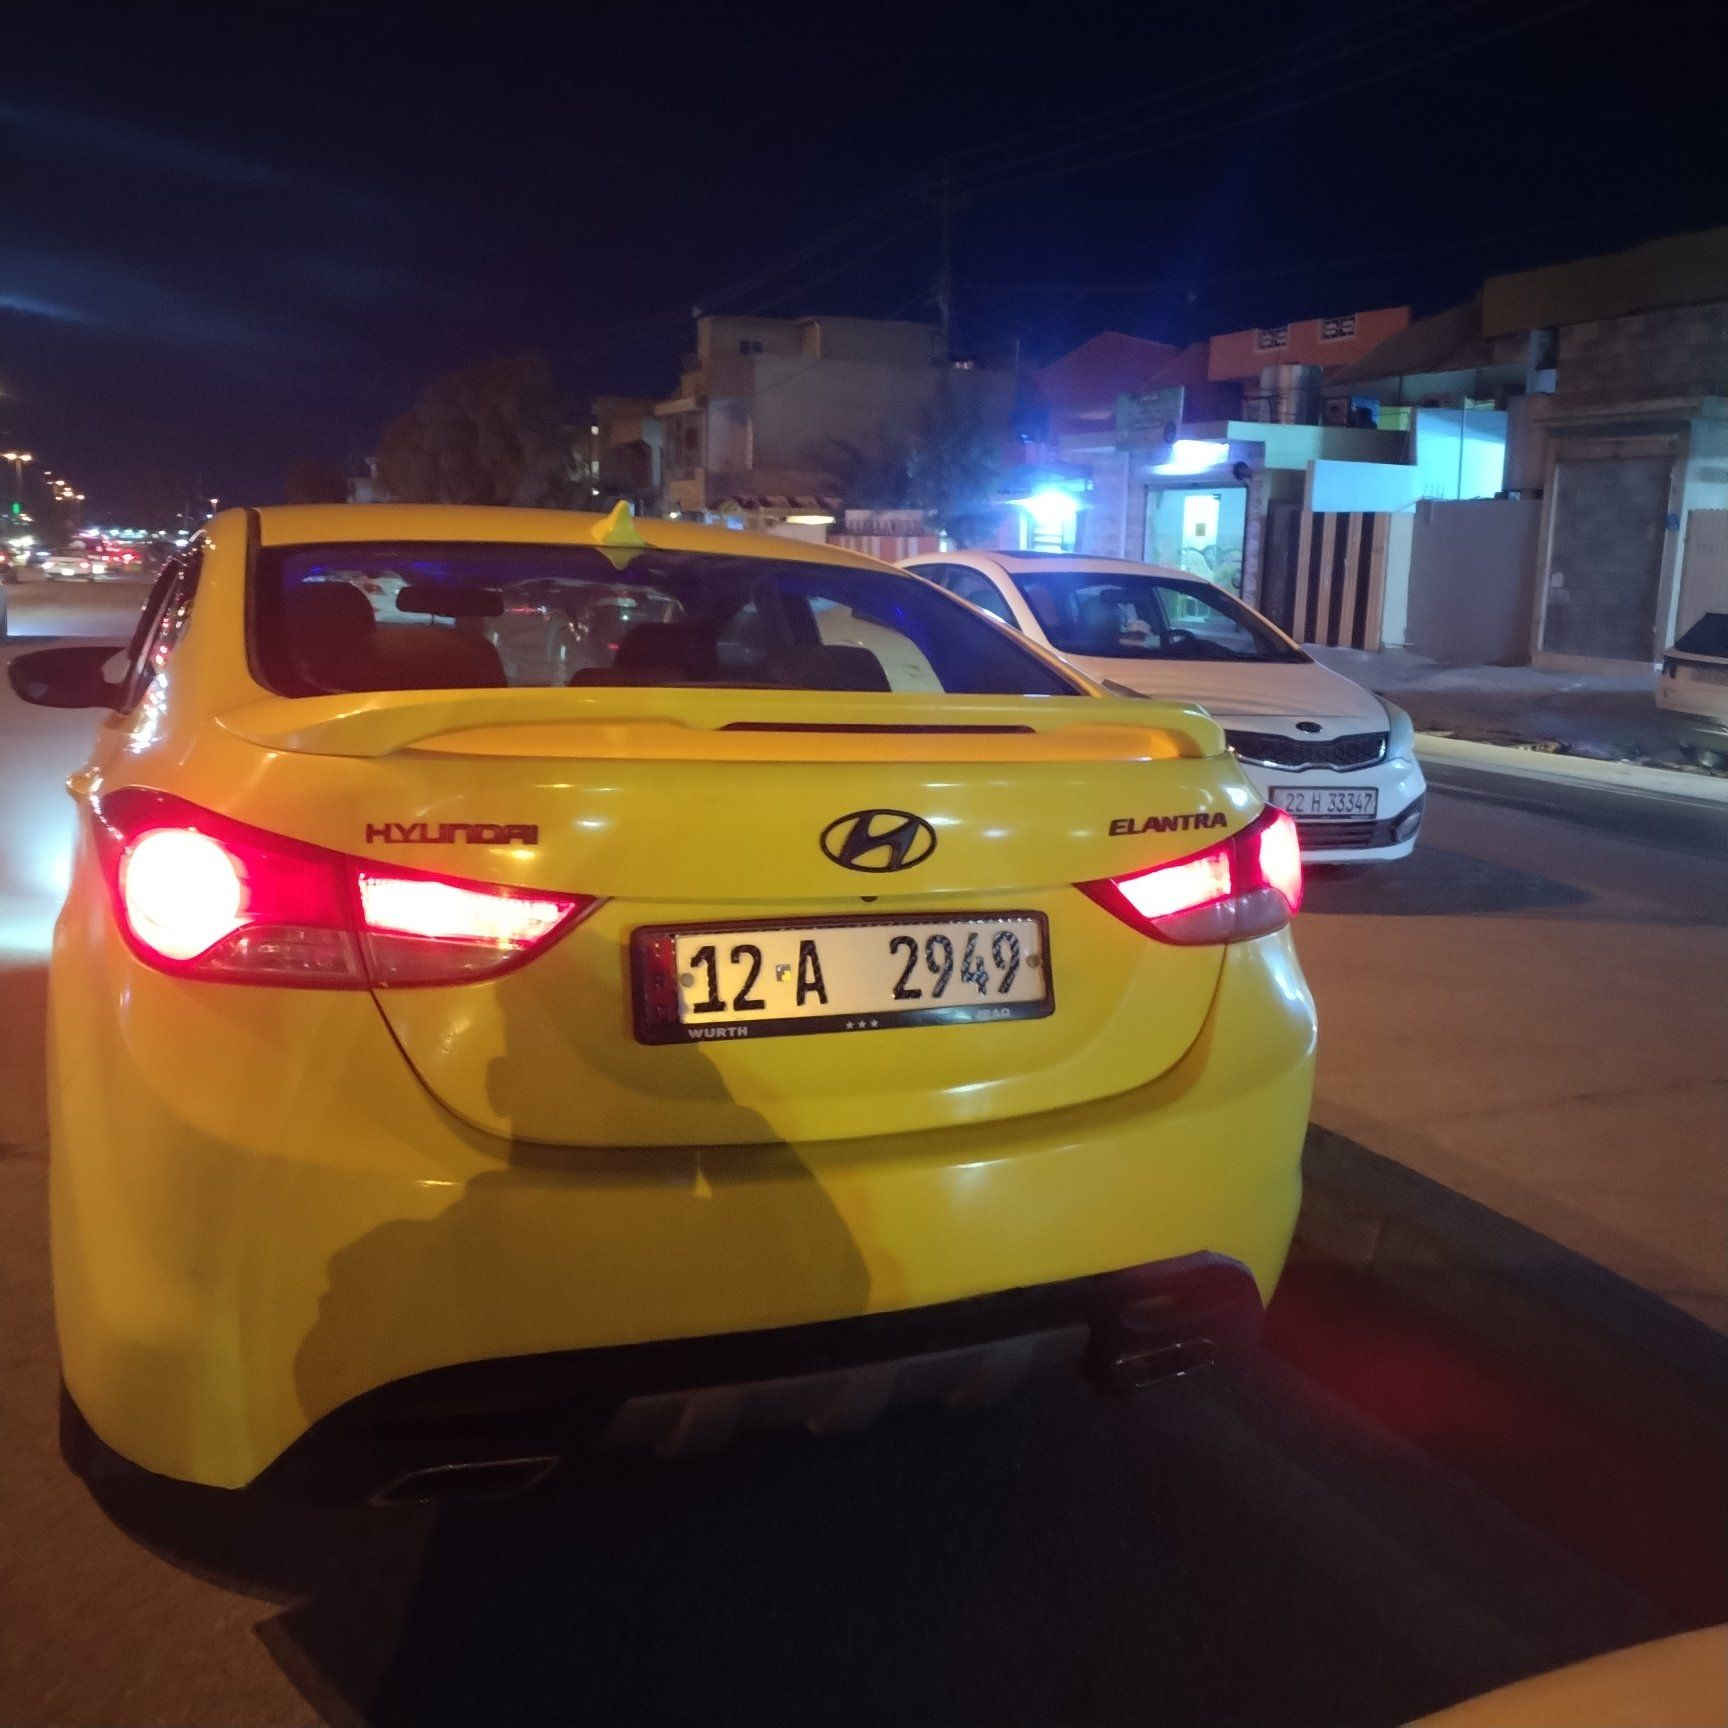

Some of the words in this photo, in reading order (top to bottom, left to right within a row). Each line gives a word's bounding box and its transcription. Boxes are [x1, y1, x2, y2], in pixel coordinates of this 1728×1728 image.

[1286, 793, 1304, 812] 22
[1312, 792, 1321, 812] H
[1327, 793, 1373, 812] 33347
[1109, 812, 1227, 836] ELANTRA
[690, 944, 765, 1014] 12
[797, 940, 828, 1006] A
[889, 931, 1020, 1000] 2949
[688, 1026, 748, 1039] WURTH
